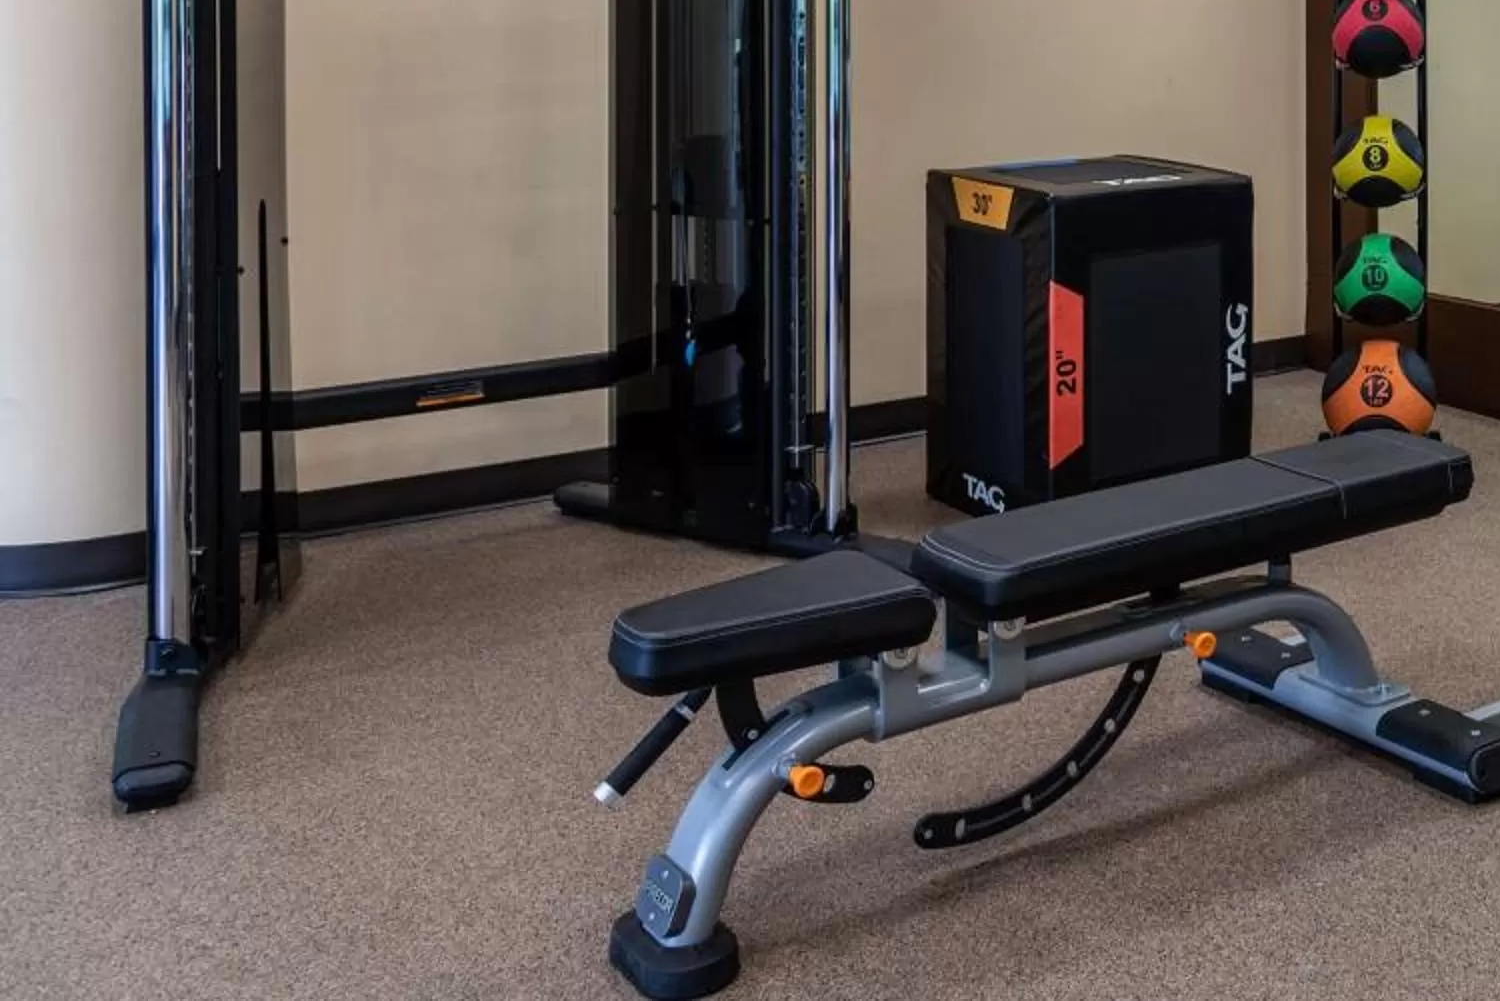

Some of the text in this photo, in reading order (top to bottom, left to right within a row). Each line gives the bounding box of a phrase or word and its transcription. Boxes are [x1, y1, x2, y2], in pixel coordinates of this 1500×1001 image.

[1370, 146, 1381, 164] 8
[1366, 268, 1384, 284] 10
[1226, 302, 1248, 395] TAG
[1056, 350, 1077, 396] 20"
[1364, 379, 1389, 398] 12
[963, 473, 1006, 514] TAG
